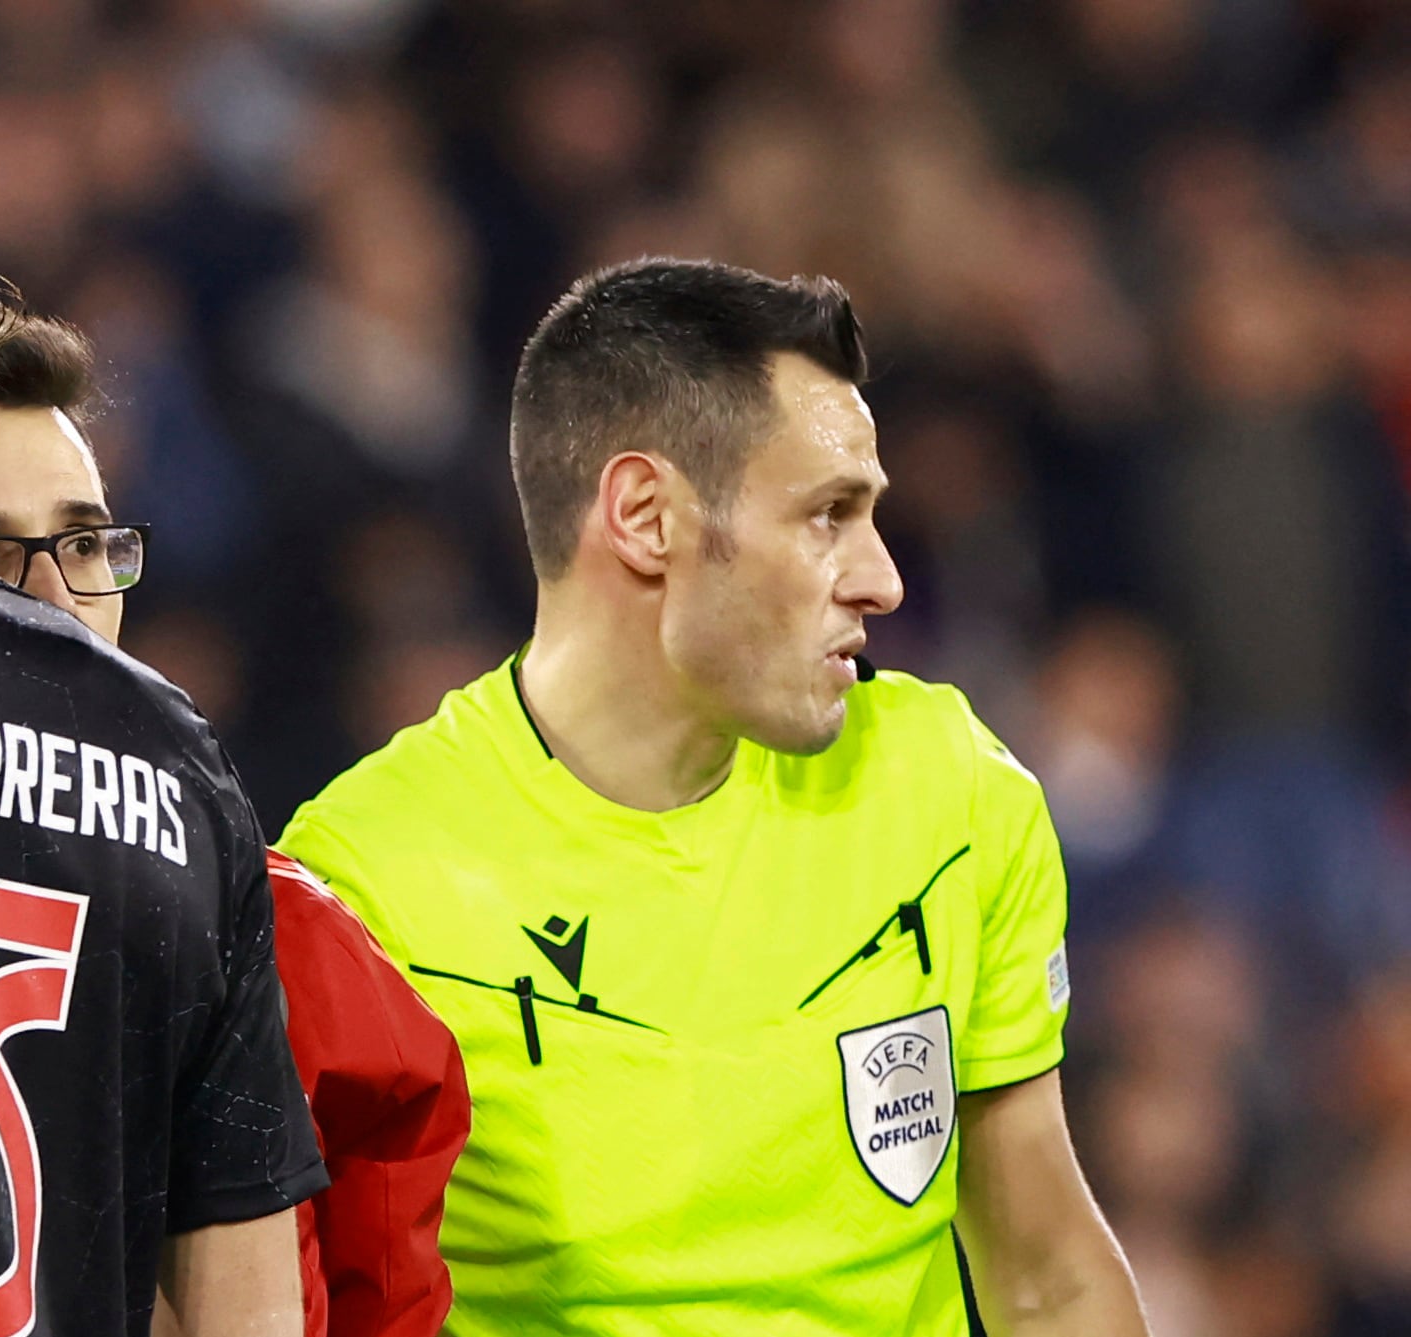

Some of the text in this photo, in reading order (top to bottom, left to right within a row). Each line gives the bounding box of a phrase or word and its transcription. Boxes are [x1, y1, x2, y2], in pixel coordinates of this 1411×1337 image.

[866, 1040, 928, 1079] UEFA
[874, 1089, 934, 1124] MATCH
[868, 1116, 944, 1153] OFFICIAL
